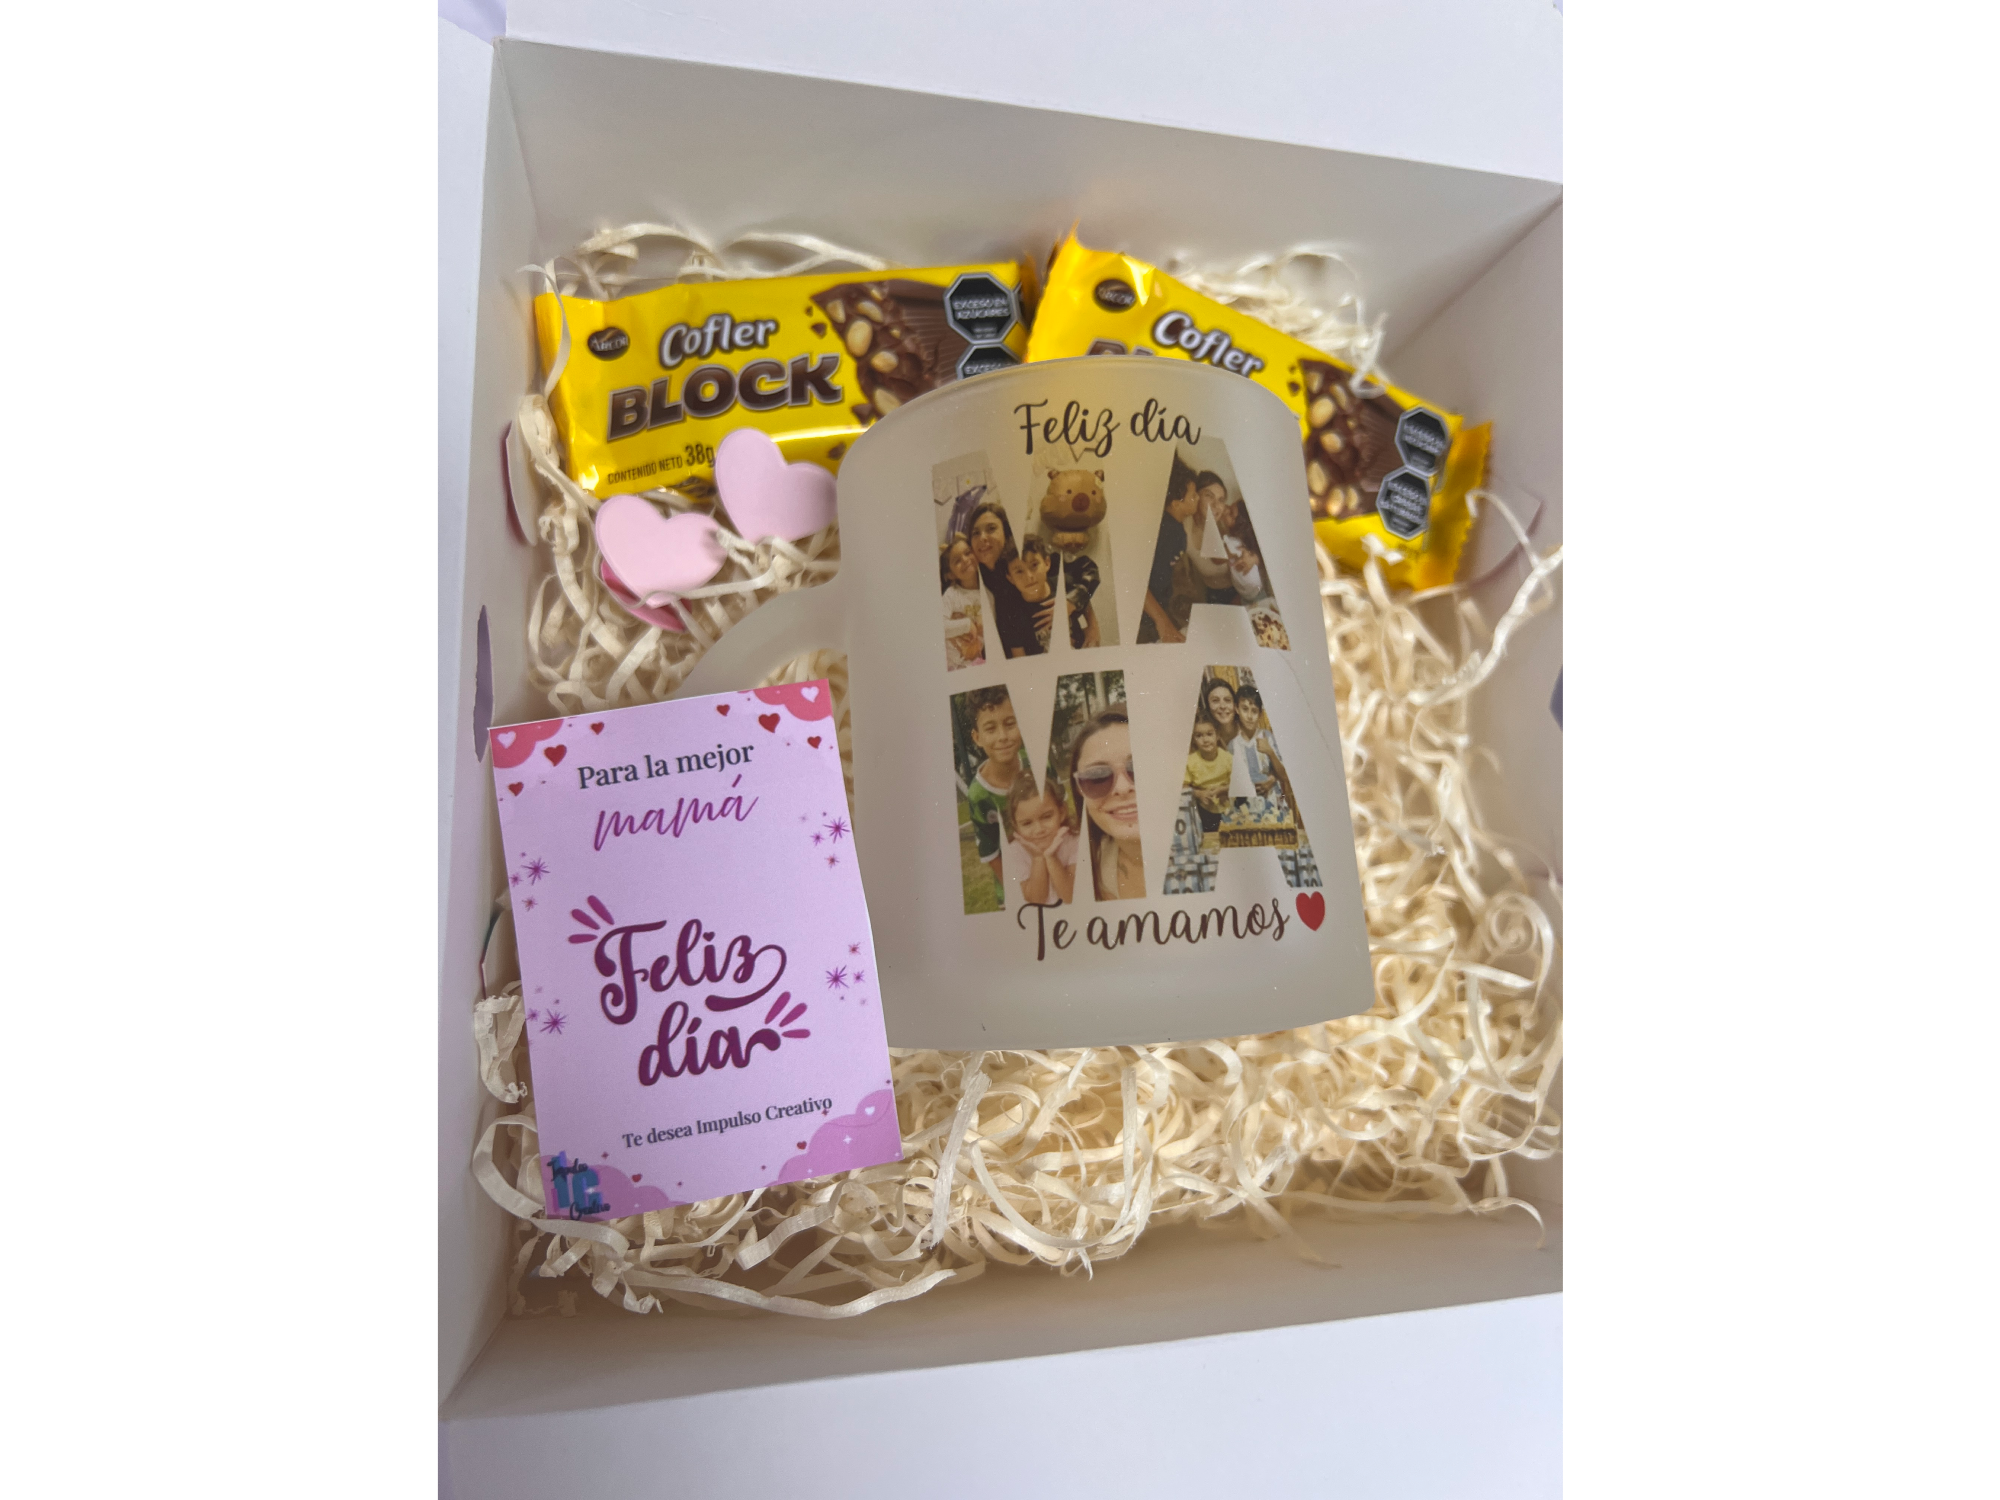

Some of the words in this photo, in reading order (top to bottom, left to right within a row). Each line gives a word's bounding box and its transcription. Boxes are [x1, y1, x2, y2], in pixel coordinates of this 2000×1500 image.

[658, 312, 779, 370] Cofler
[1152, 310, 1265, 377] Cofler
[606, 353, 845, 442] BLOCK
[1014, 398, 1120, 458] Feliz
[1130, 397, 1202, 446] día
[607, 461, 657, 485] CONTENIDO
[658, 455, 684, 473] NETO
[684, 442, 716, 469] 38g
[577, 761, 640, 790] Para
[644, 753, 671, 779] la
[676, 743, 754, 774] mejor
[593, 773, 759, 851] mamá
[1017, 898, 1077, 961] Te
[1086, 895, 1290, 951] amamos
[594, 918, 787, 1025] Feliz
[638, 1000, 781, 1087] día
[622, 1132, 643, 1149] Te
[647, 1124, 693, 1145] desea
[696, 1111, 762, 1135] Impulso
[765, 1097, 833, 1121] Creativo
